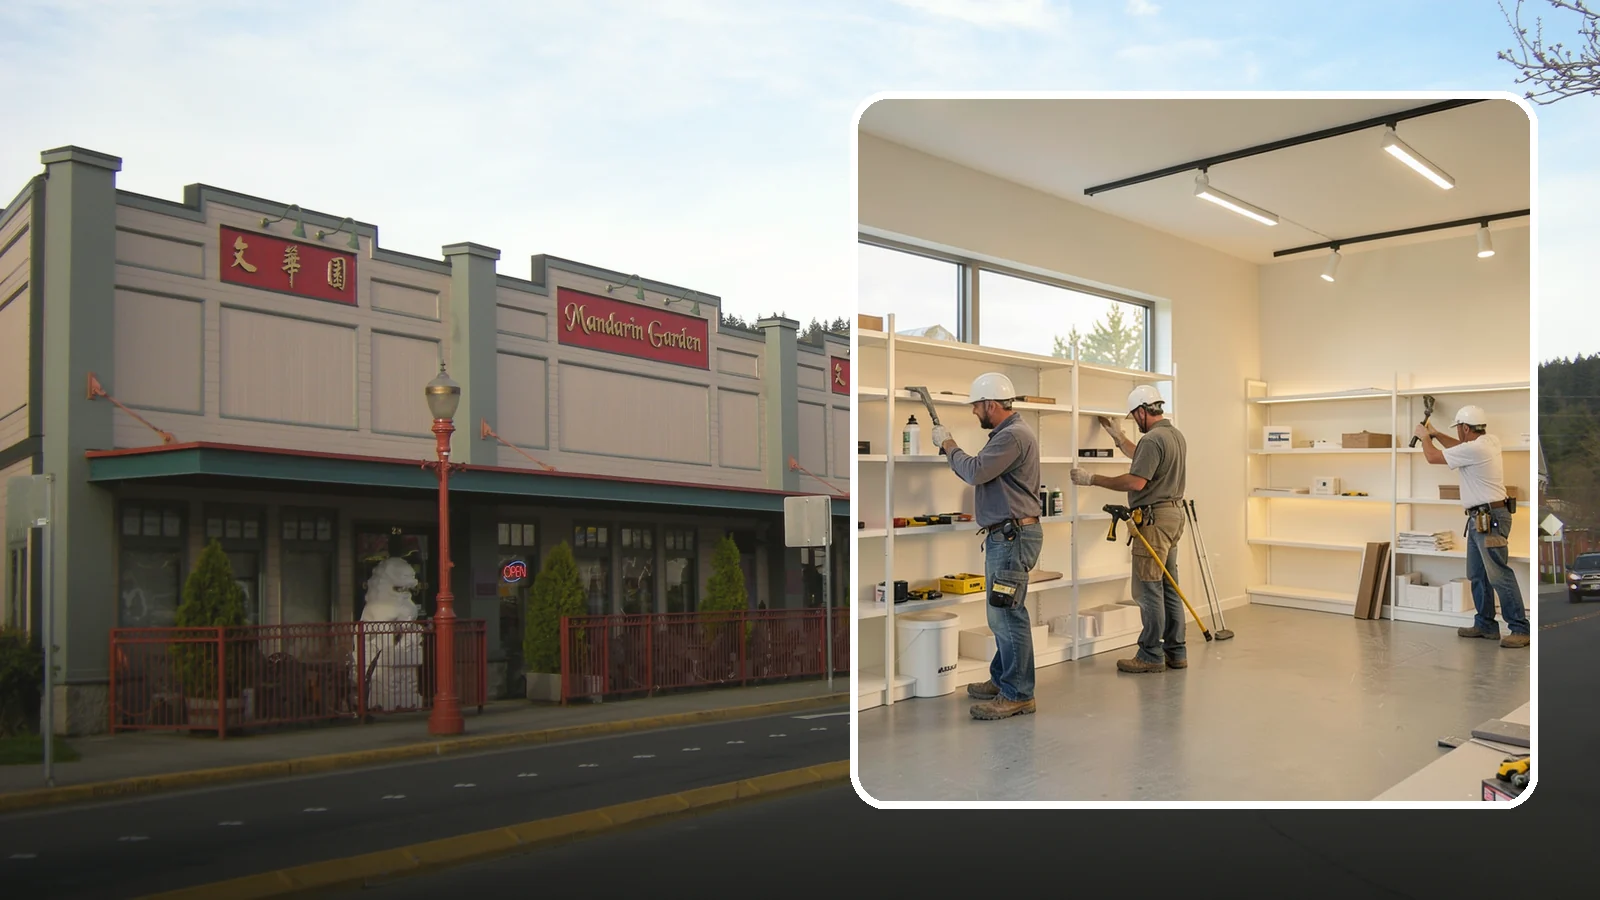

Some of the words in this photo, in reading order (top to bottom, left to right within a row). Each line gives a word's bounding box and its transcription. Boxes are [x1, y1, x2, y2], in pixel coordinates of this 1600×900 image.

[231, 235, 346, 291] 文華園
[564, 302, 644, 341] Mandarin
[648, 320, 701, 352] Garden
[503, 565, 527, 578] OPEN
